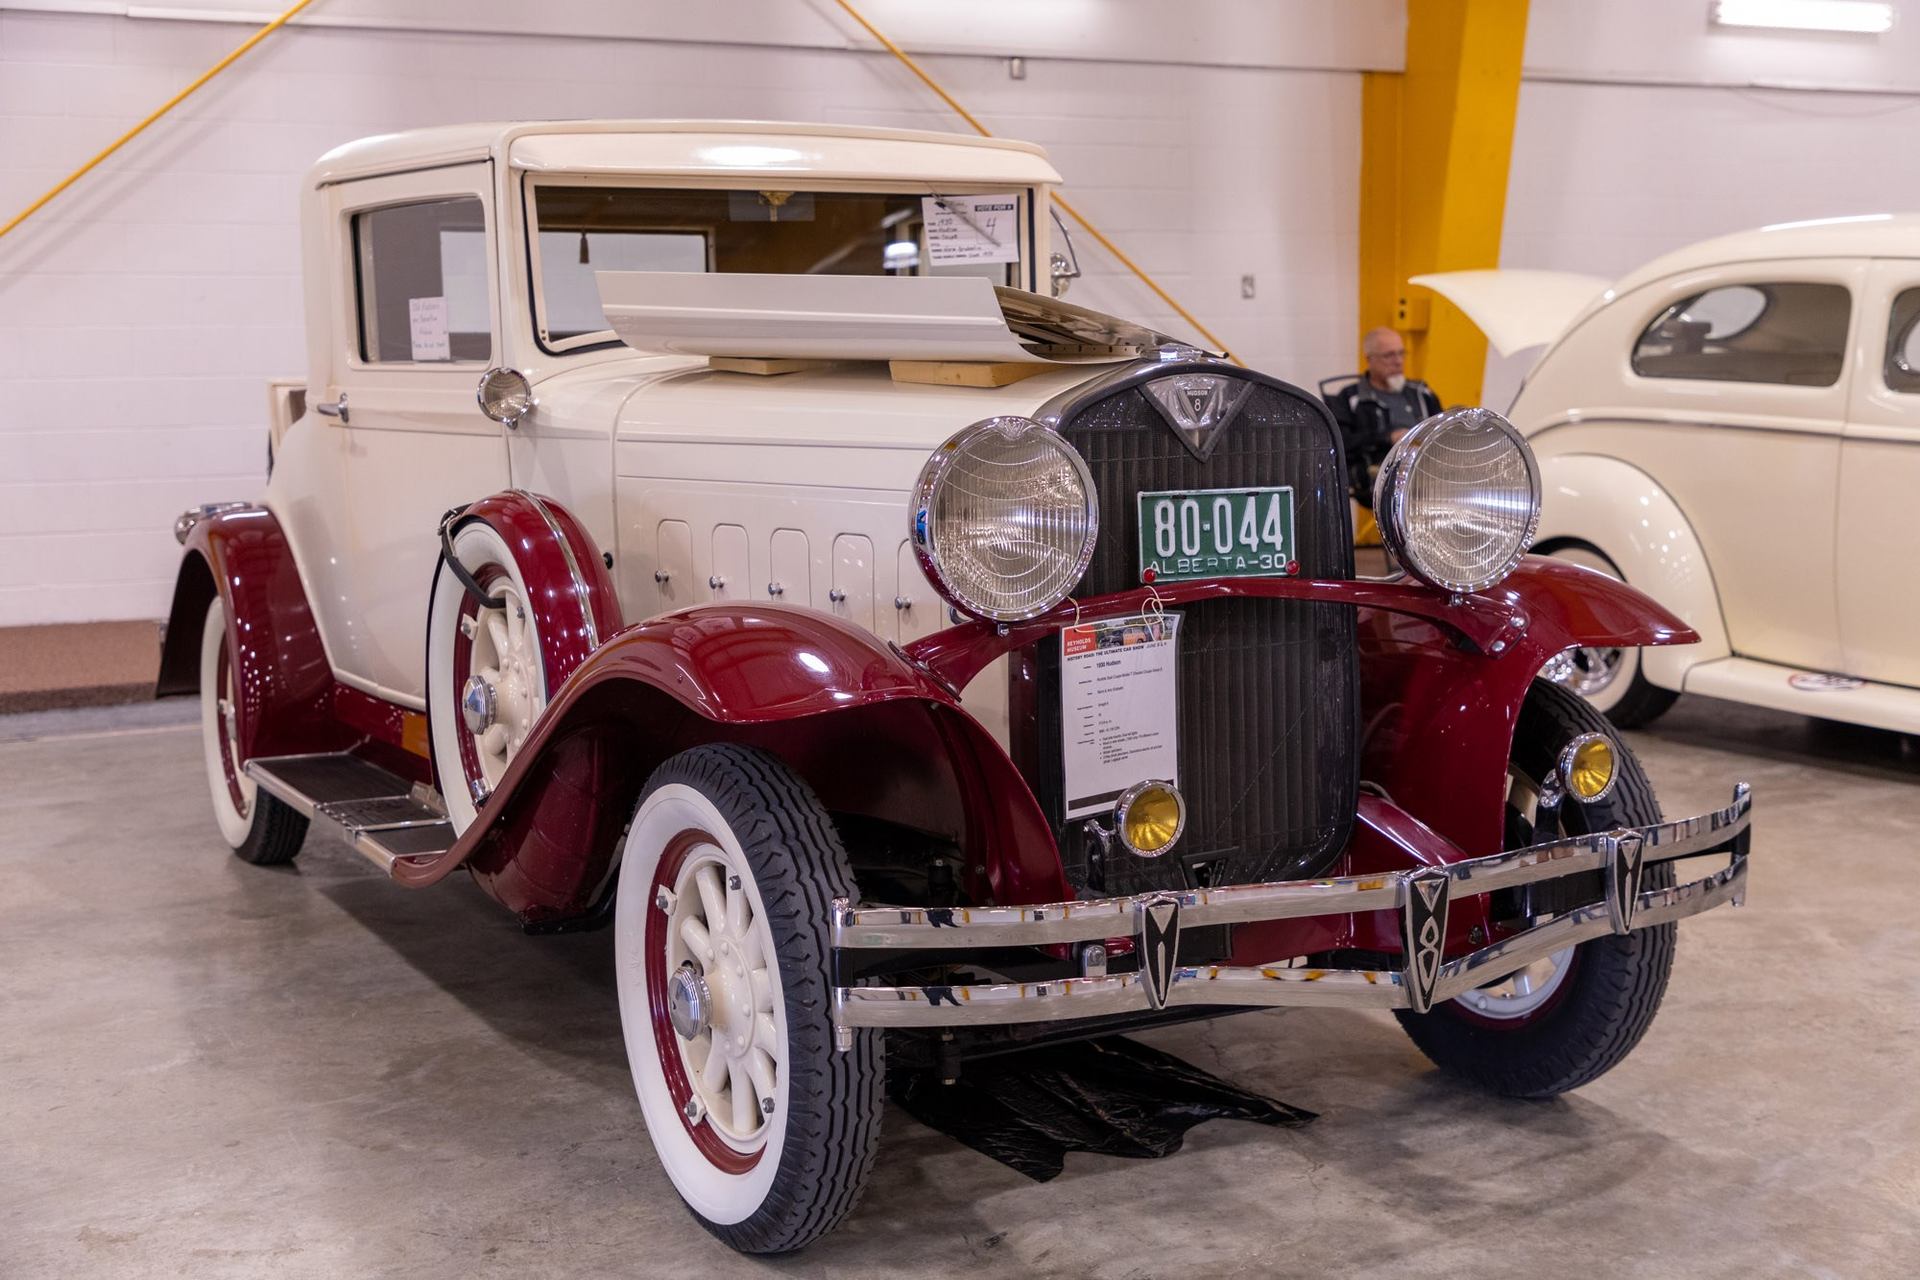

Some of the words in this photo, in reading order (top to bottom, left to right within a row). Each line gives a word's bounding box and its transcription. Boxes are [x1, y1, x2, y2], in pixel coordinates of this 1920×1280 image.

[1194, 398, 1202, 412] 8
[1154, 492, 1284, 558] 80-044
[1149, 552, 1287, 575] ALBERTA-30
[1067, 638, 1091, 647] REYNOLDS
[1104, 648, 1122, 656] ULTIMATE
